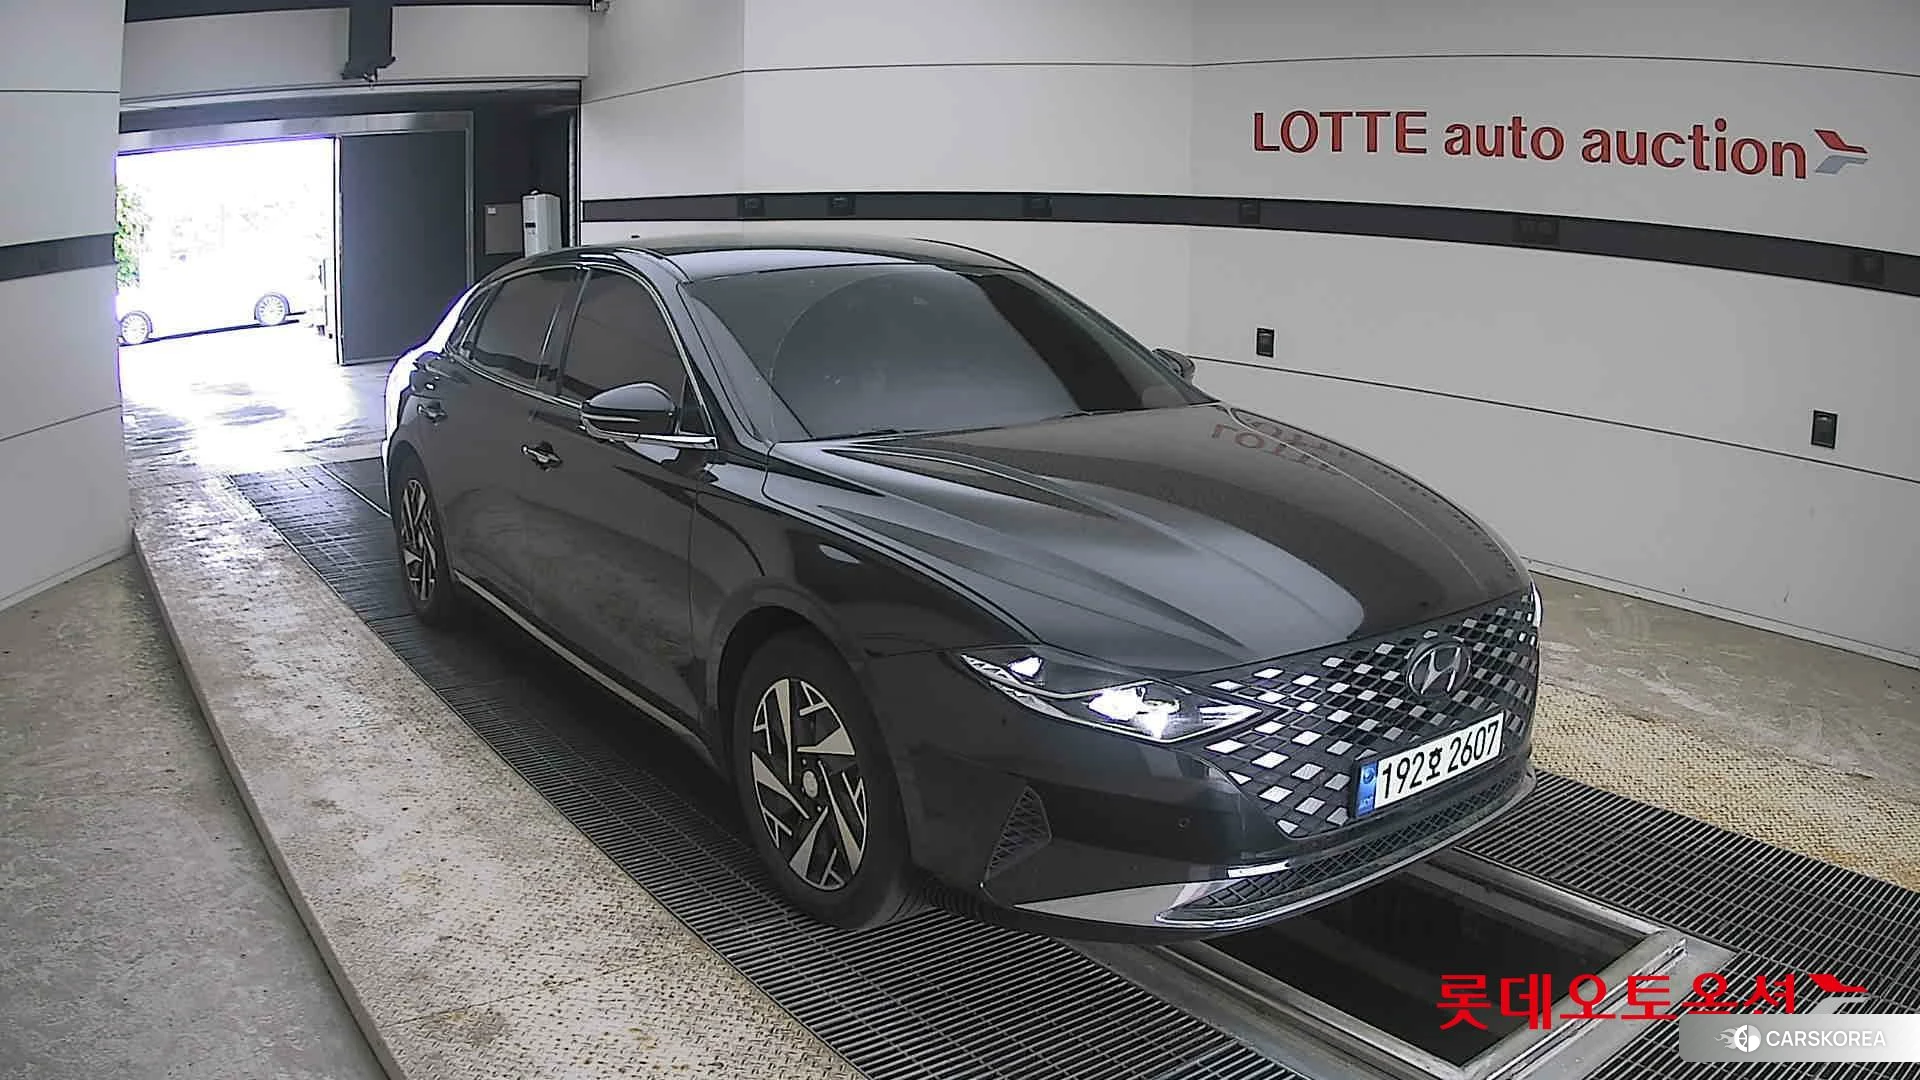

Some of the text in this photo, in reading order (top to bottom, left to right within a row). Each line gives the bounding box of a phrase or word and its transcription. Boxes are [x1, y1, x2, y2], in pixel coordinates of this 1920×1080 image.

[1253, 110, 1807, 180] LOTTE auto auction
[1382, 719, 1500, 799] 192호 2607
